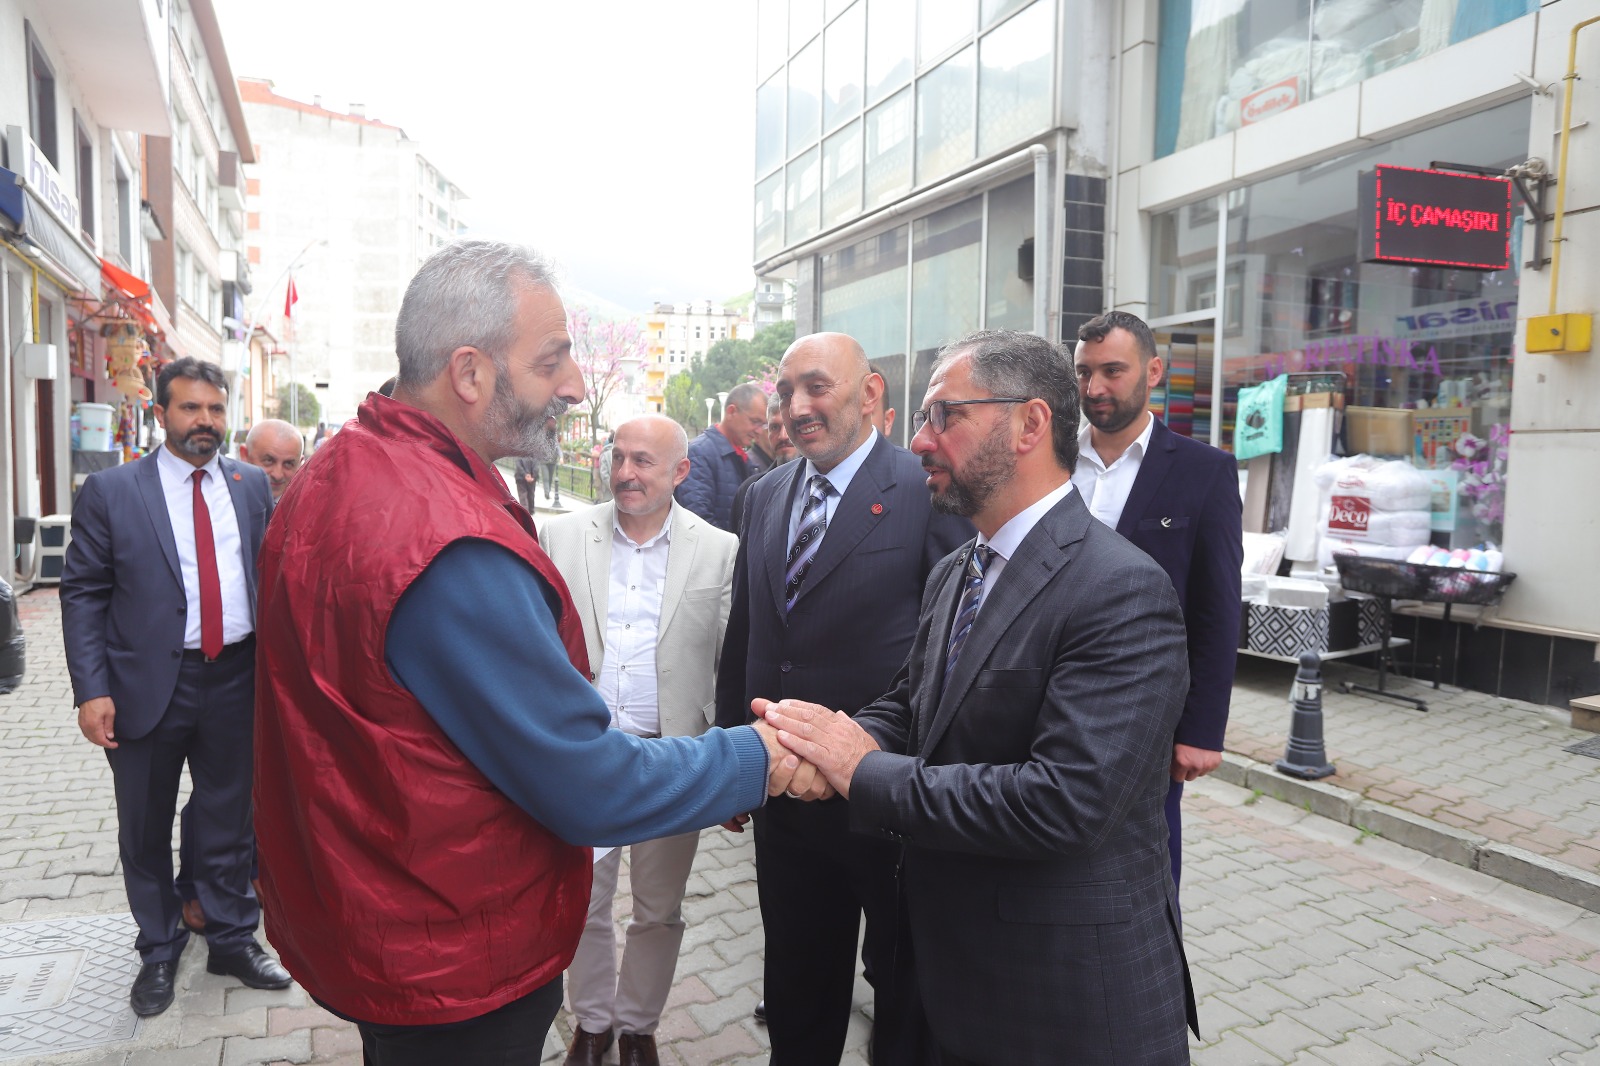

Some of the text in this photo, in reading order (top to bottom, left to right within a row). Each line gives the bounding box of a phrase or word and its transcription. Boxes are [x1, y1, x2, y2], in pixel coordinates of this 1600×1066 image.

[29, 142, 78, 229] hisar
[1387, 197, 1499, 232] İÇ ÇAMAŞIRI
[1329, 505, 1368, 523] Deco
